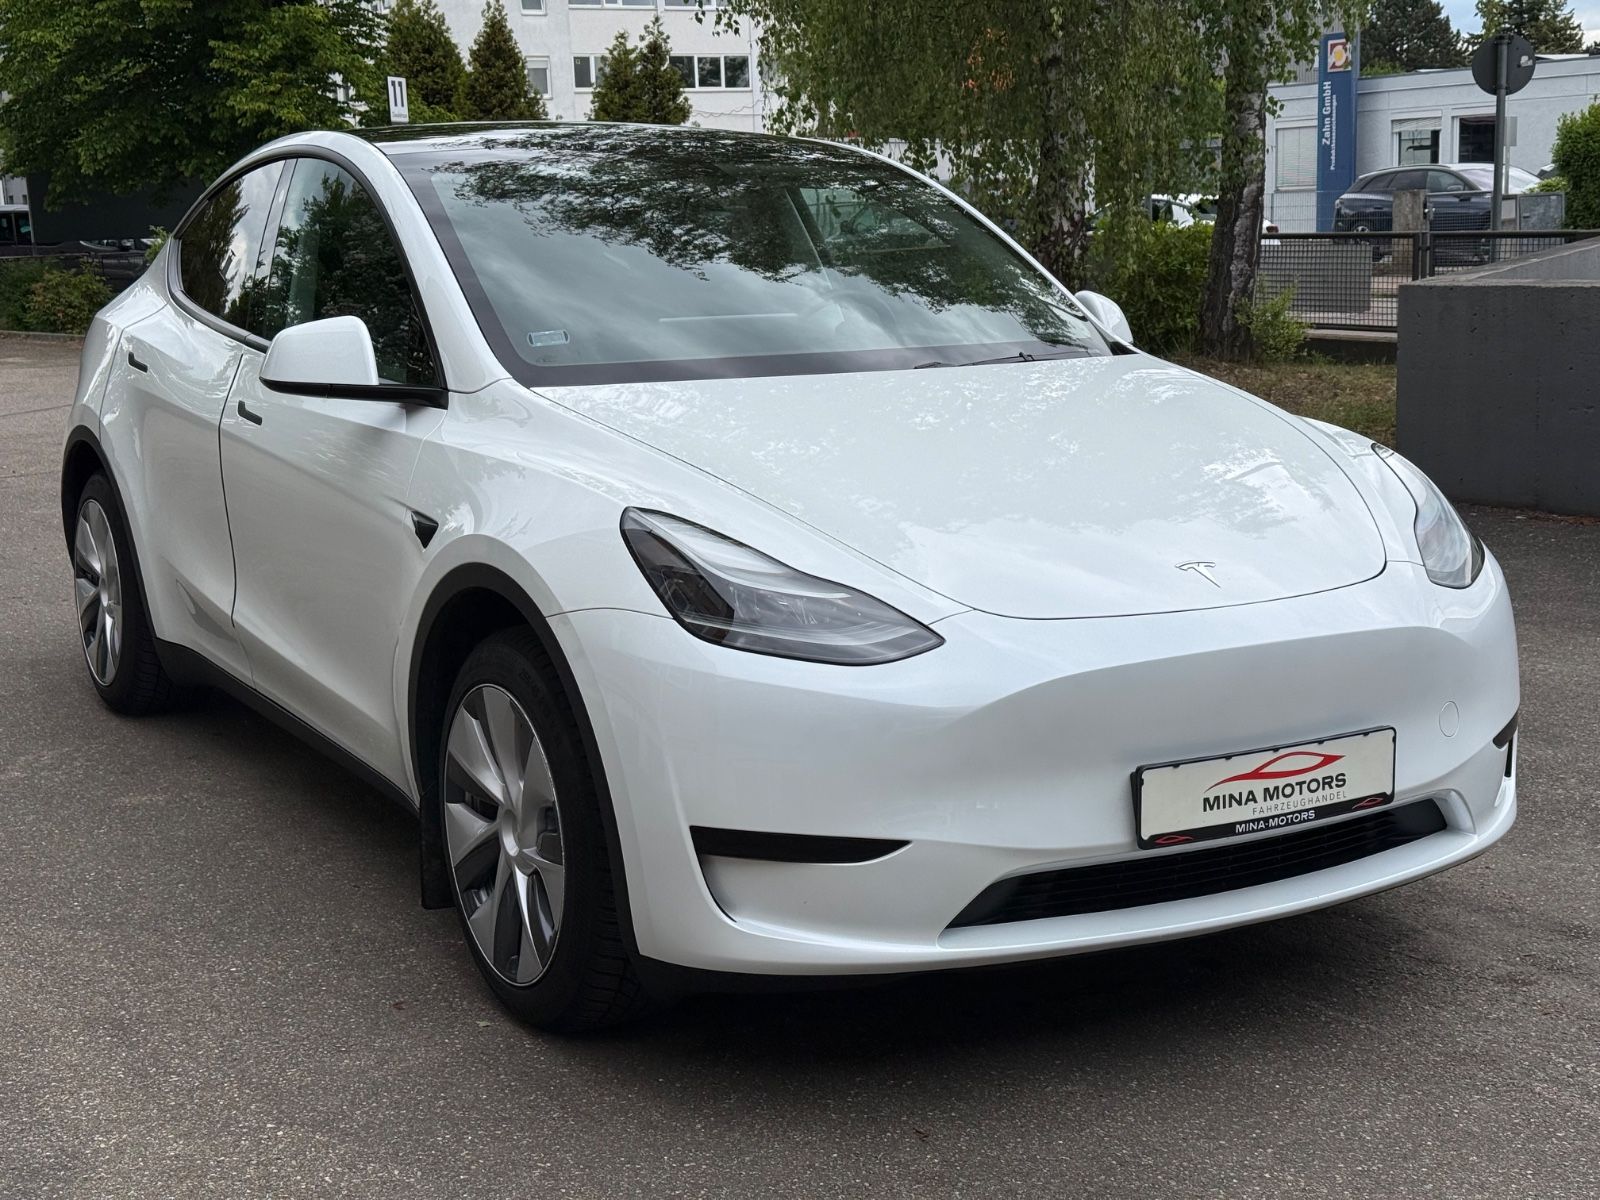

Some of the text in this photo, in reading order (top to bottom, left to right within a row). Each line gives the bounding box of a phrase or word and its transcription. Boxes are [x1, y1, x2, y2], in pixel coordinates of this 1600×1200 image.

[391, 80, 405, 107] 11
[1322, 81, 1332, 146] Zahn GmbH
[1202, 772, 1347, 812] MINA MOTORS
[1252, 790, 1348, 816] FAHRZEUGHANDEL
[1235, 810, 1316, 833] MINA-MOTORS
